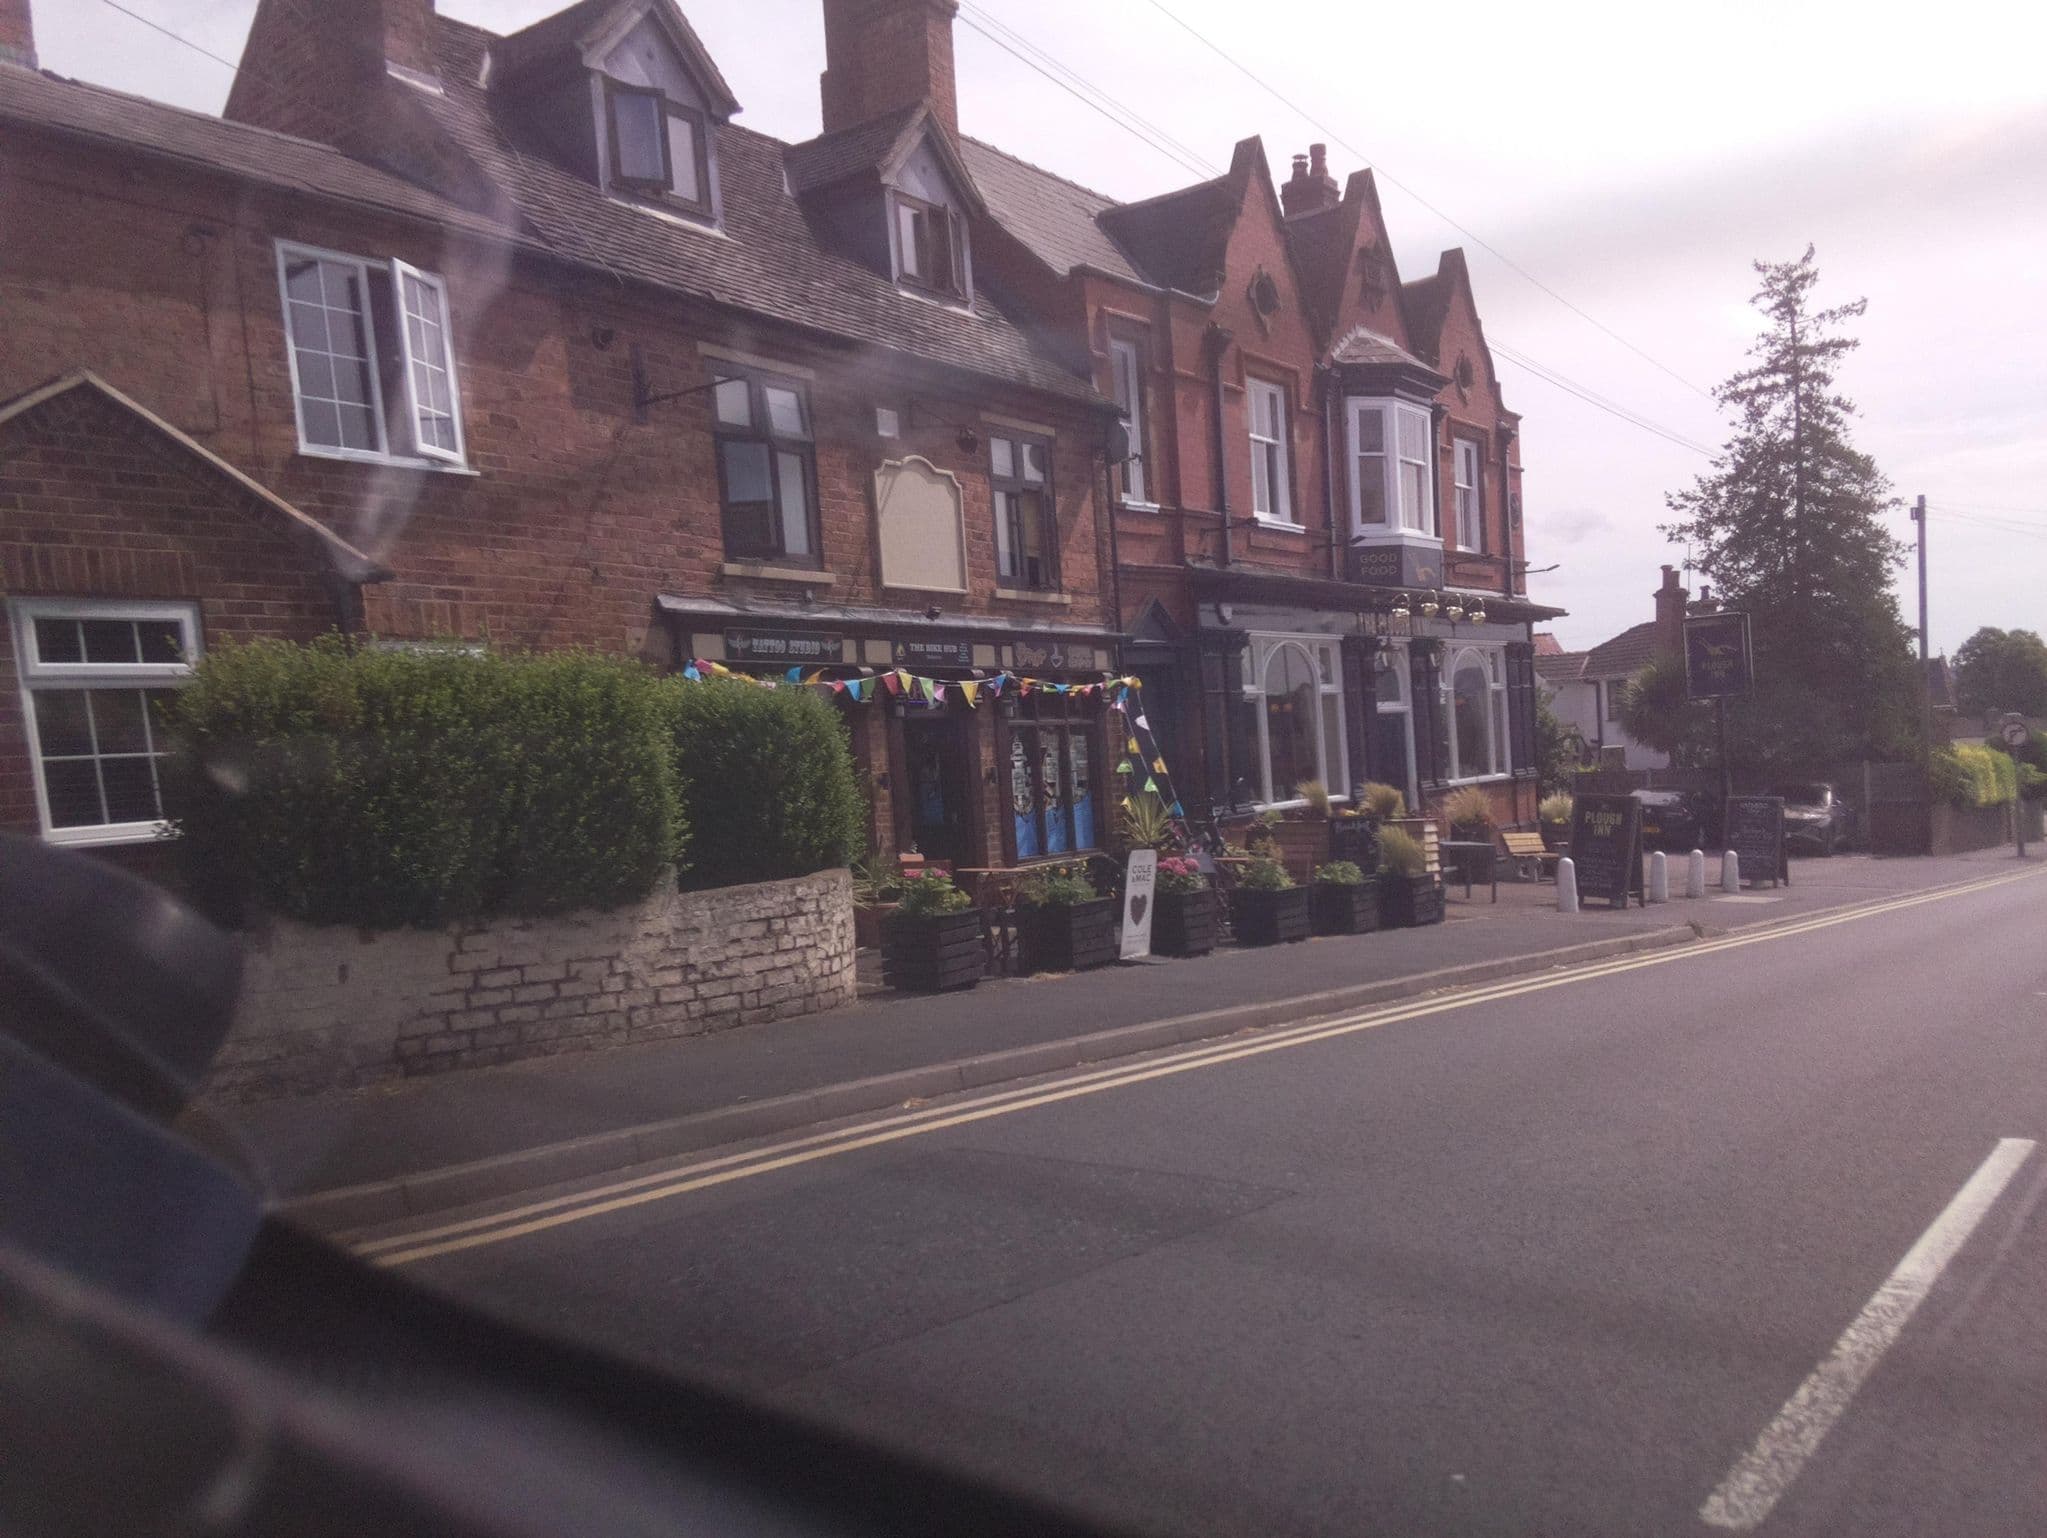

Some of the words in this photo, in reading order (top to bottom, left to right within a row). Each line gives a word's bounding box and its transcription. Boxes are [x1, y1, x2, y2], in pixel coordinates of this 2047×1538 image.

[1360, 552, 1397, 564] GOOD
[1361, 564, 1397, 576] FOOD
[752, 638, 786, 653] TATTOO
[788, 640, 820, 655] STUDIO
[909, 643, 925, 653] THE
[925, 644, 943, 653] BIKE
[1585, 810, 1623, 824] PLOUGH
